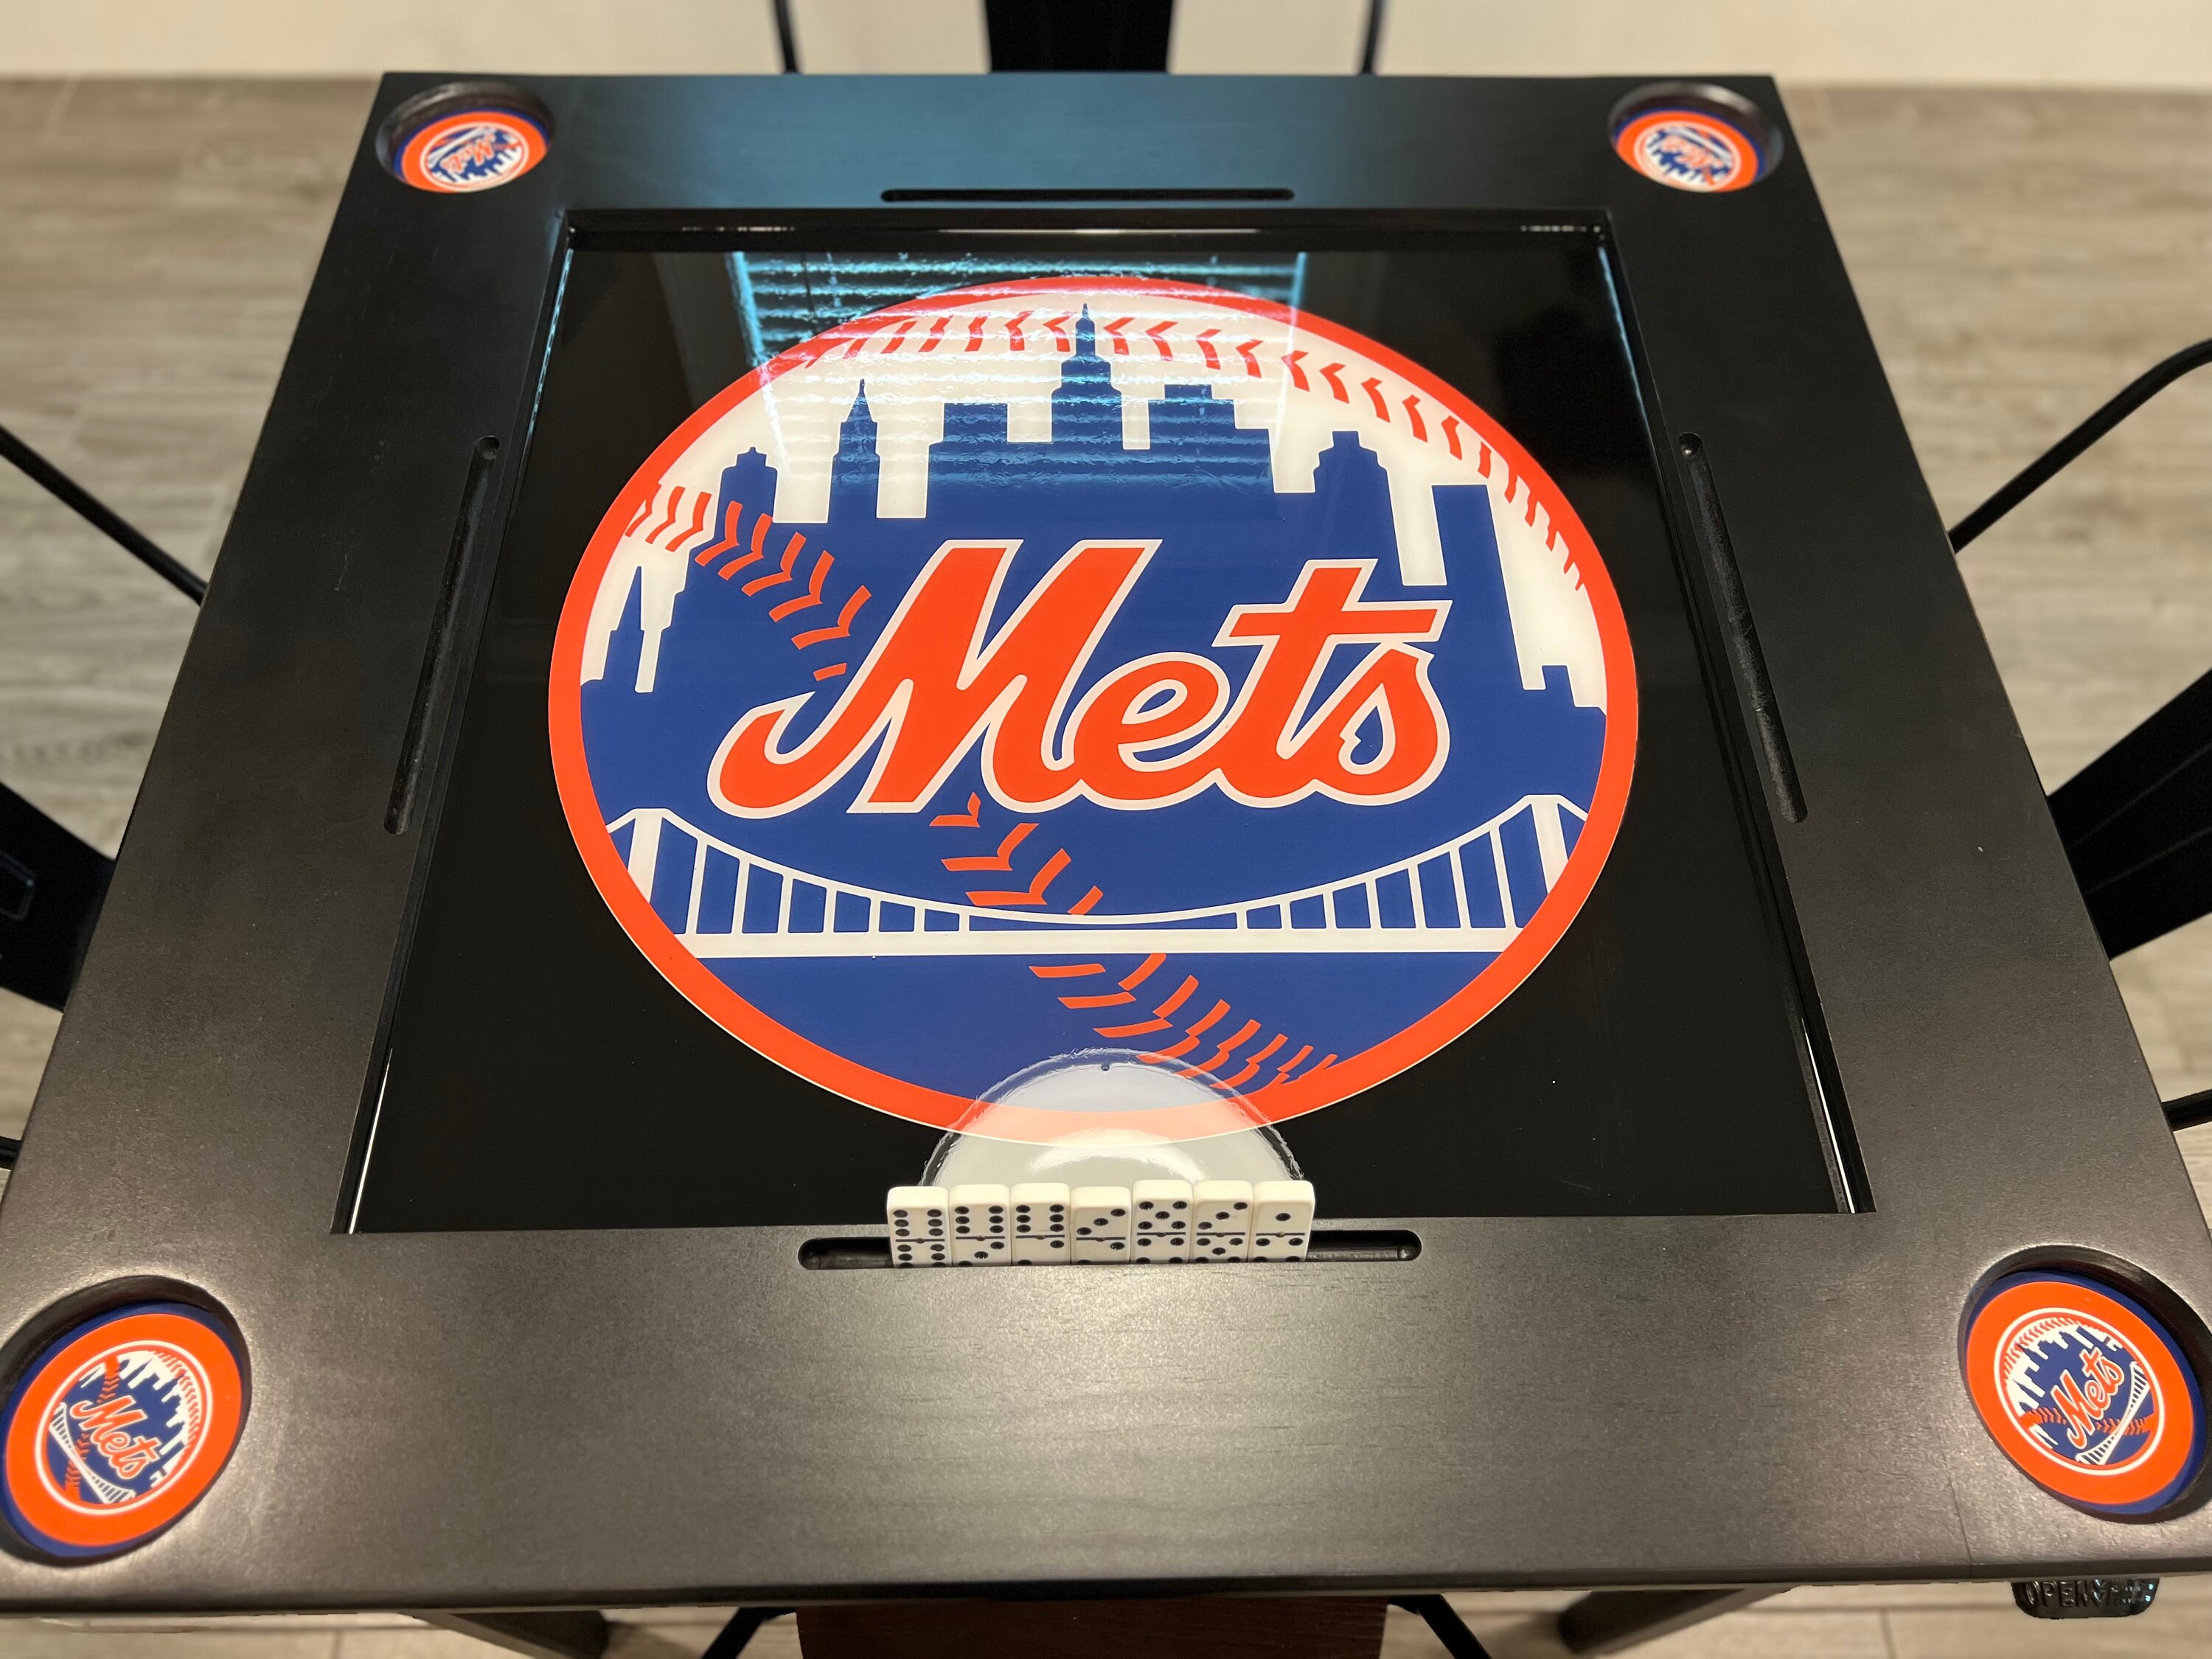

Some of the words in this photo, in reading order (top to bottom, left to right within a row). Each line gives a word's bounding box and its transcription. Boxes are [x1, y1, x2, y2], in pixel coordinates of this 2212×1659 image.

[706, 539, 1453, 819] Mets
[69, 1394, 162, 1480] Mets
[2051, 1346, 2124, 1450] Mets
